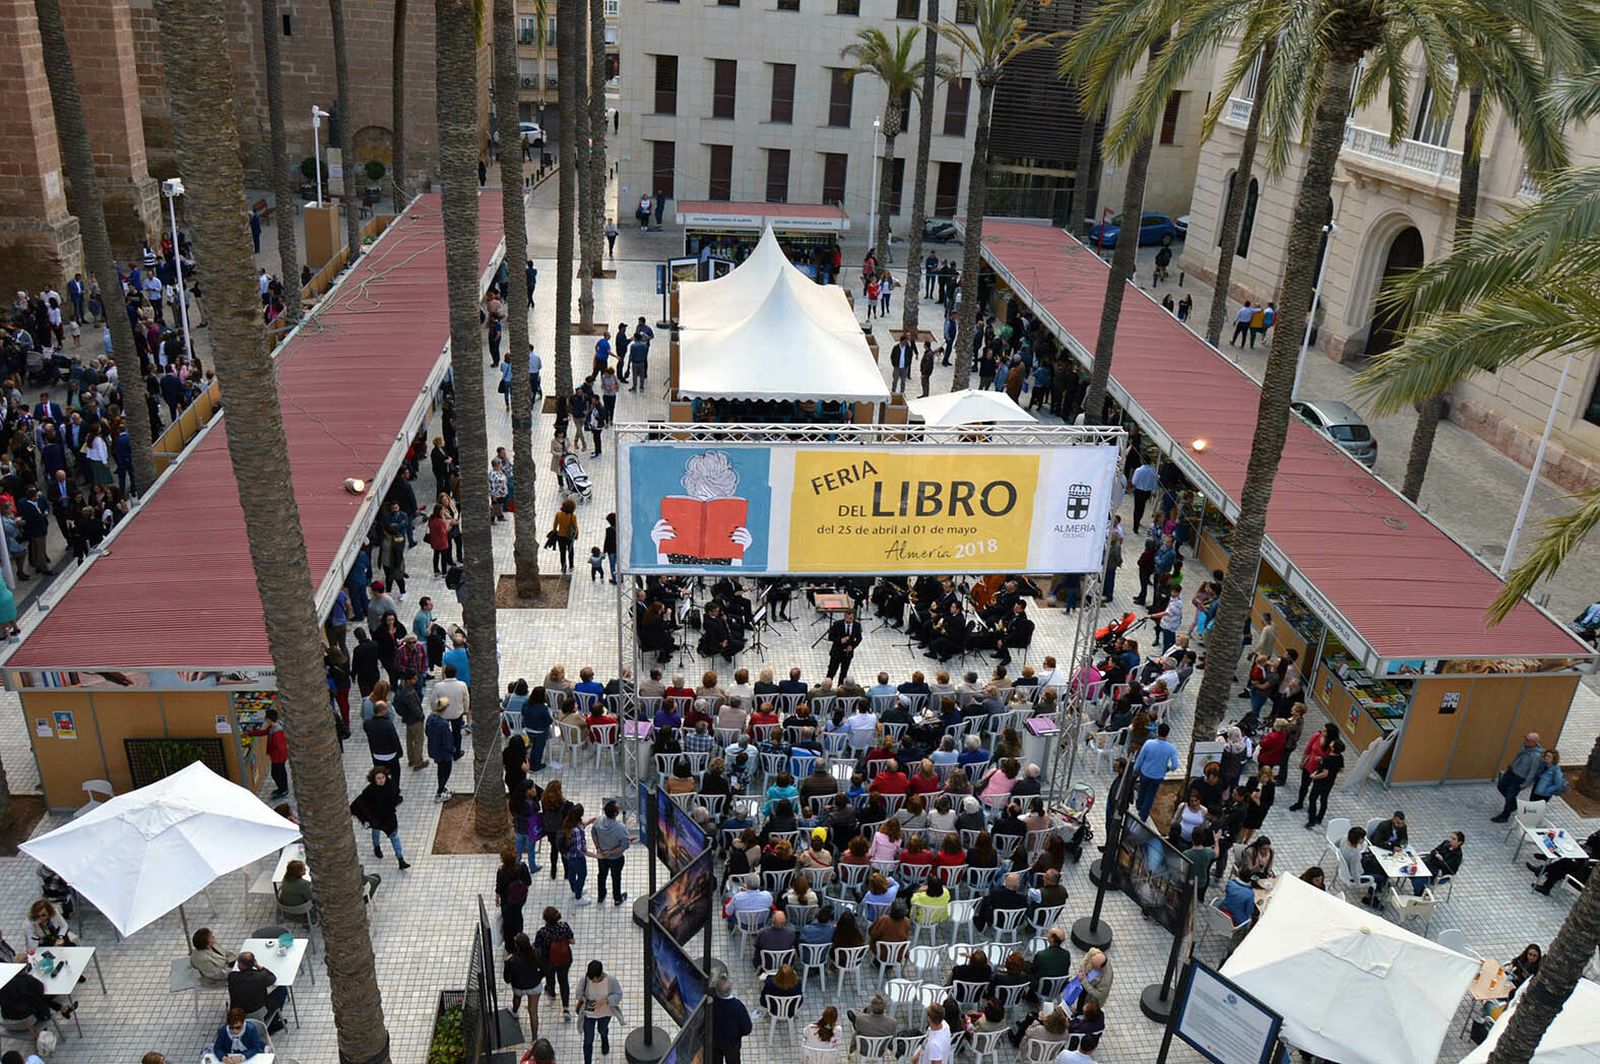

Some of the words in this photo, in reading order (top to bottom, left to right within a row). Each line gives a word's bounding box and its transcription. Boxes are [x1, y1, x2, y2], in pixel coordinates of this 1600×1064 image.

[811, 460, 878, 495] FERIA
[838, 505, 867, 517] DEL
[872, 480, 1017, 517] LIBRO
[816, 525, 834, 535] del
[838, 525, 852, 535] 25
[855, 525, 869, 535] de
[872, 525, 897, 535] abril
[900, 525, 910, 535] al
[913, 525, 926, 535] 01
[930, 525, 944, 535] de
[947, 526, 978, 537] mayo
[885, 540, 951, 560] Almería
[954, 538, 998, 559] 2018
